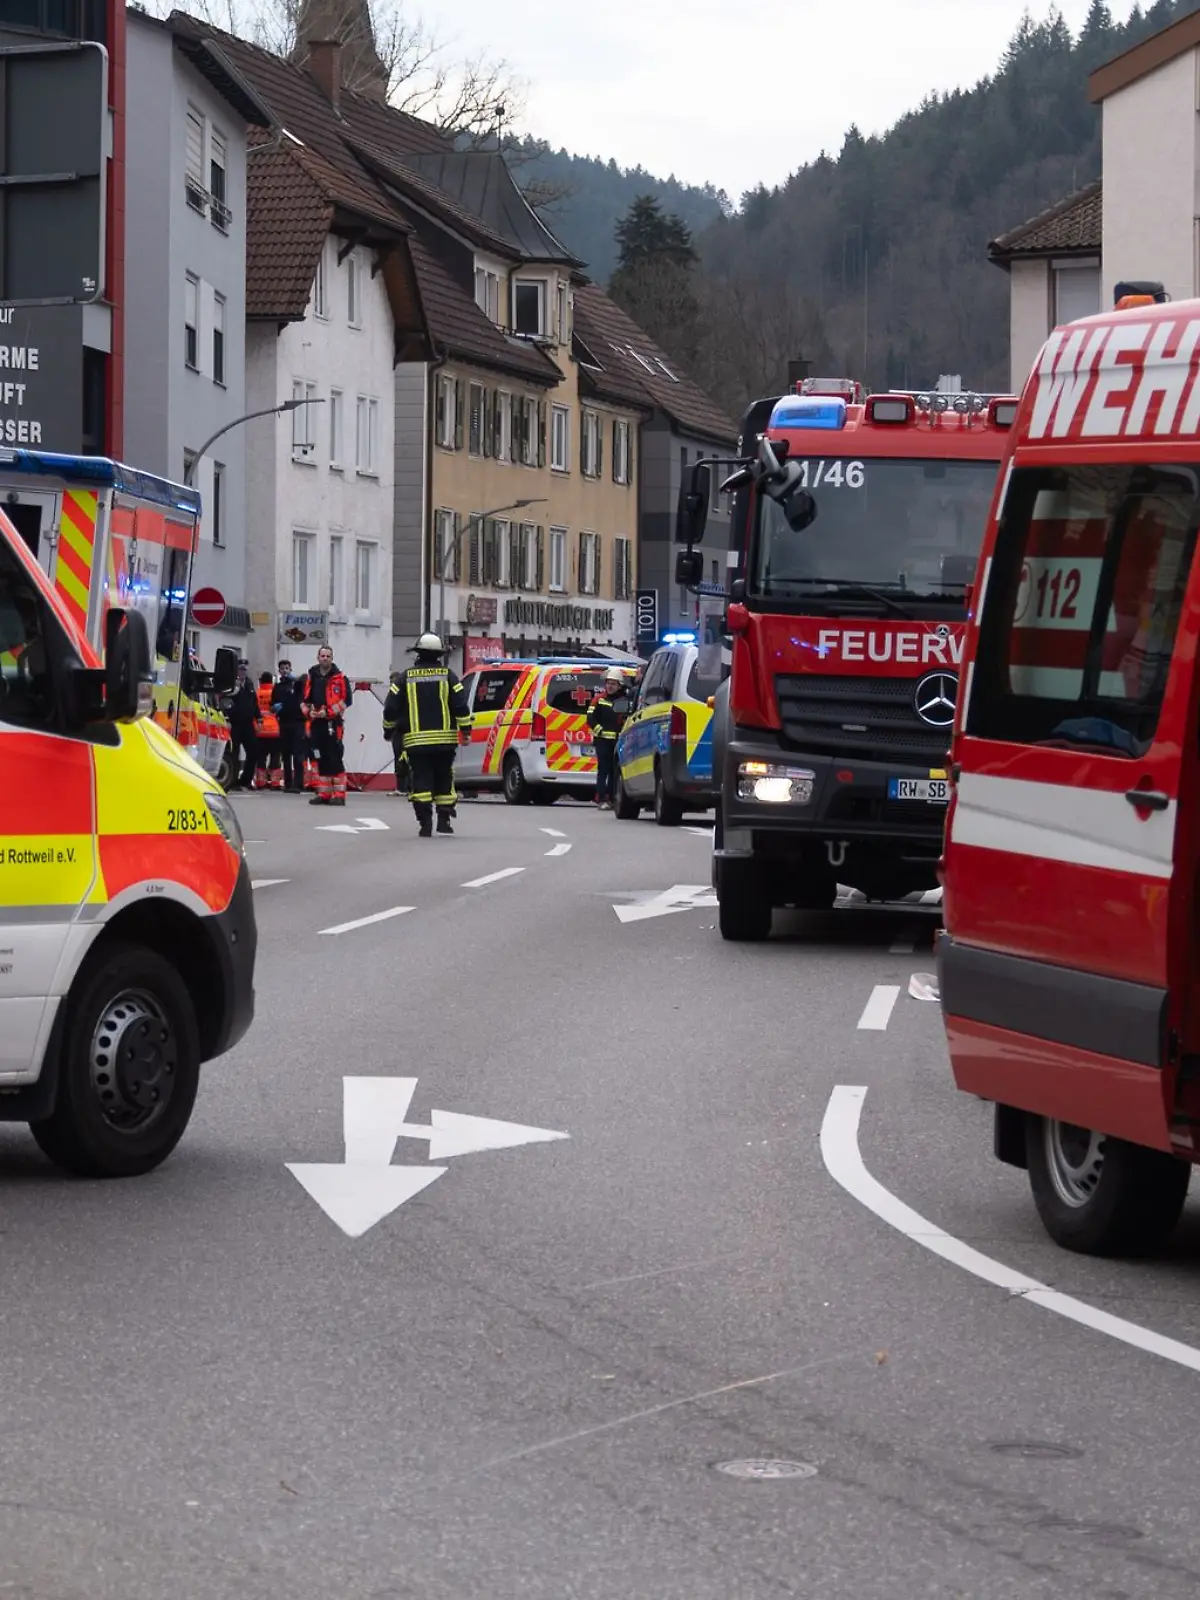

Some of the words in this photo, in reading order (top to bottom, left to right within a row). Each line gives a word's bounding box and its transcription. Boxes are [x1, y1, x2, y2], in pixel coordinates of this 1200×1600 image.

[1028, 320, 1200, 440] WEH
[1037, 567, 1081, 619] 112
[285, 613, 325, 625] Favori
[638, 595, 655, 635] TOTO
[899, 780, 917, 797] RW
[167, 809, 209, 831] 2/83-1
[8, 848, 54, 864] Rottweil
[57, 847, 76, 863] e.V.
